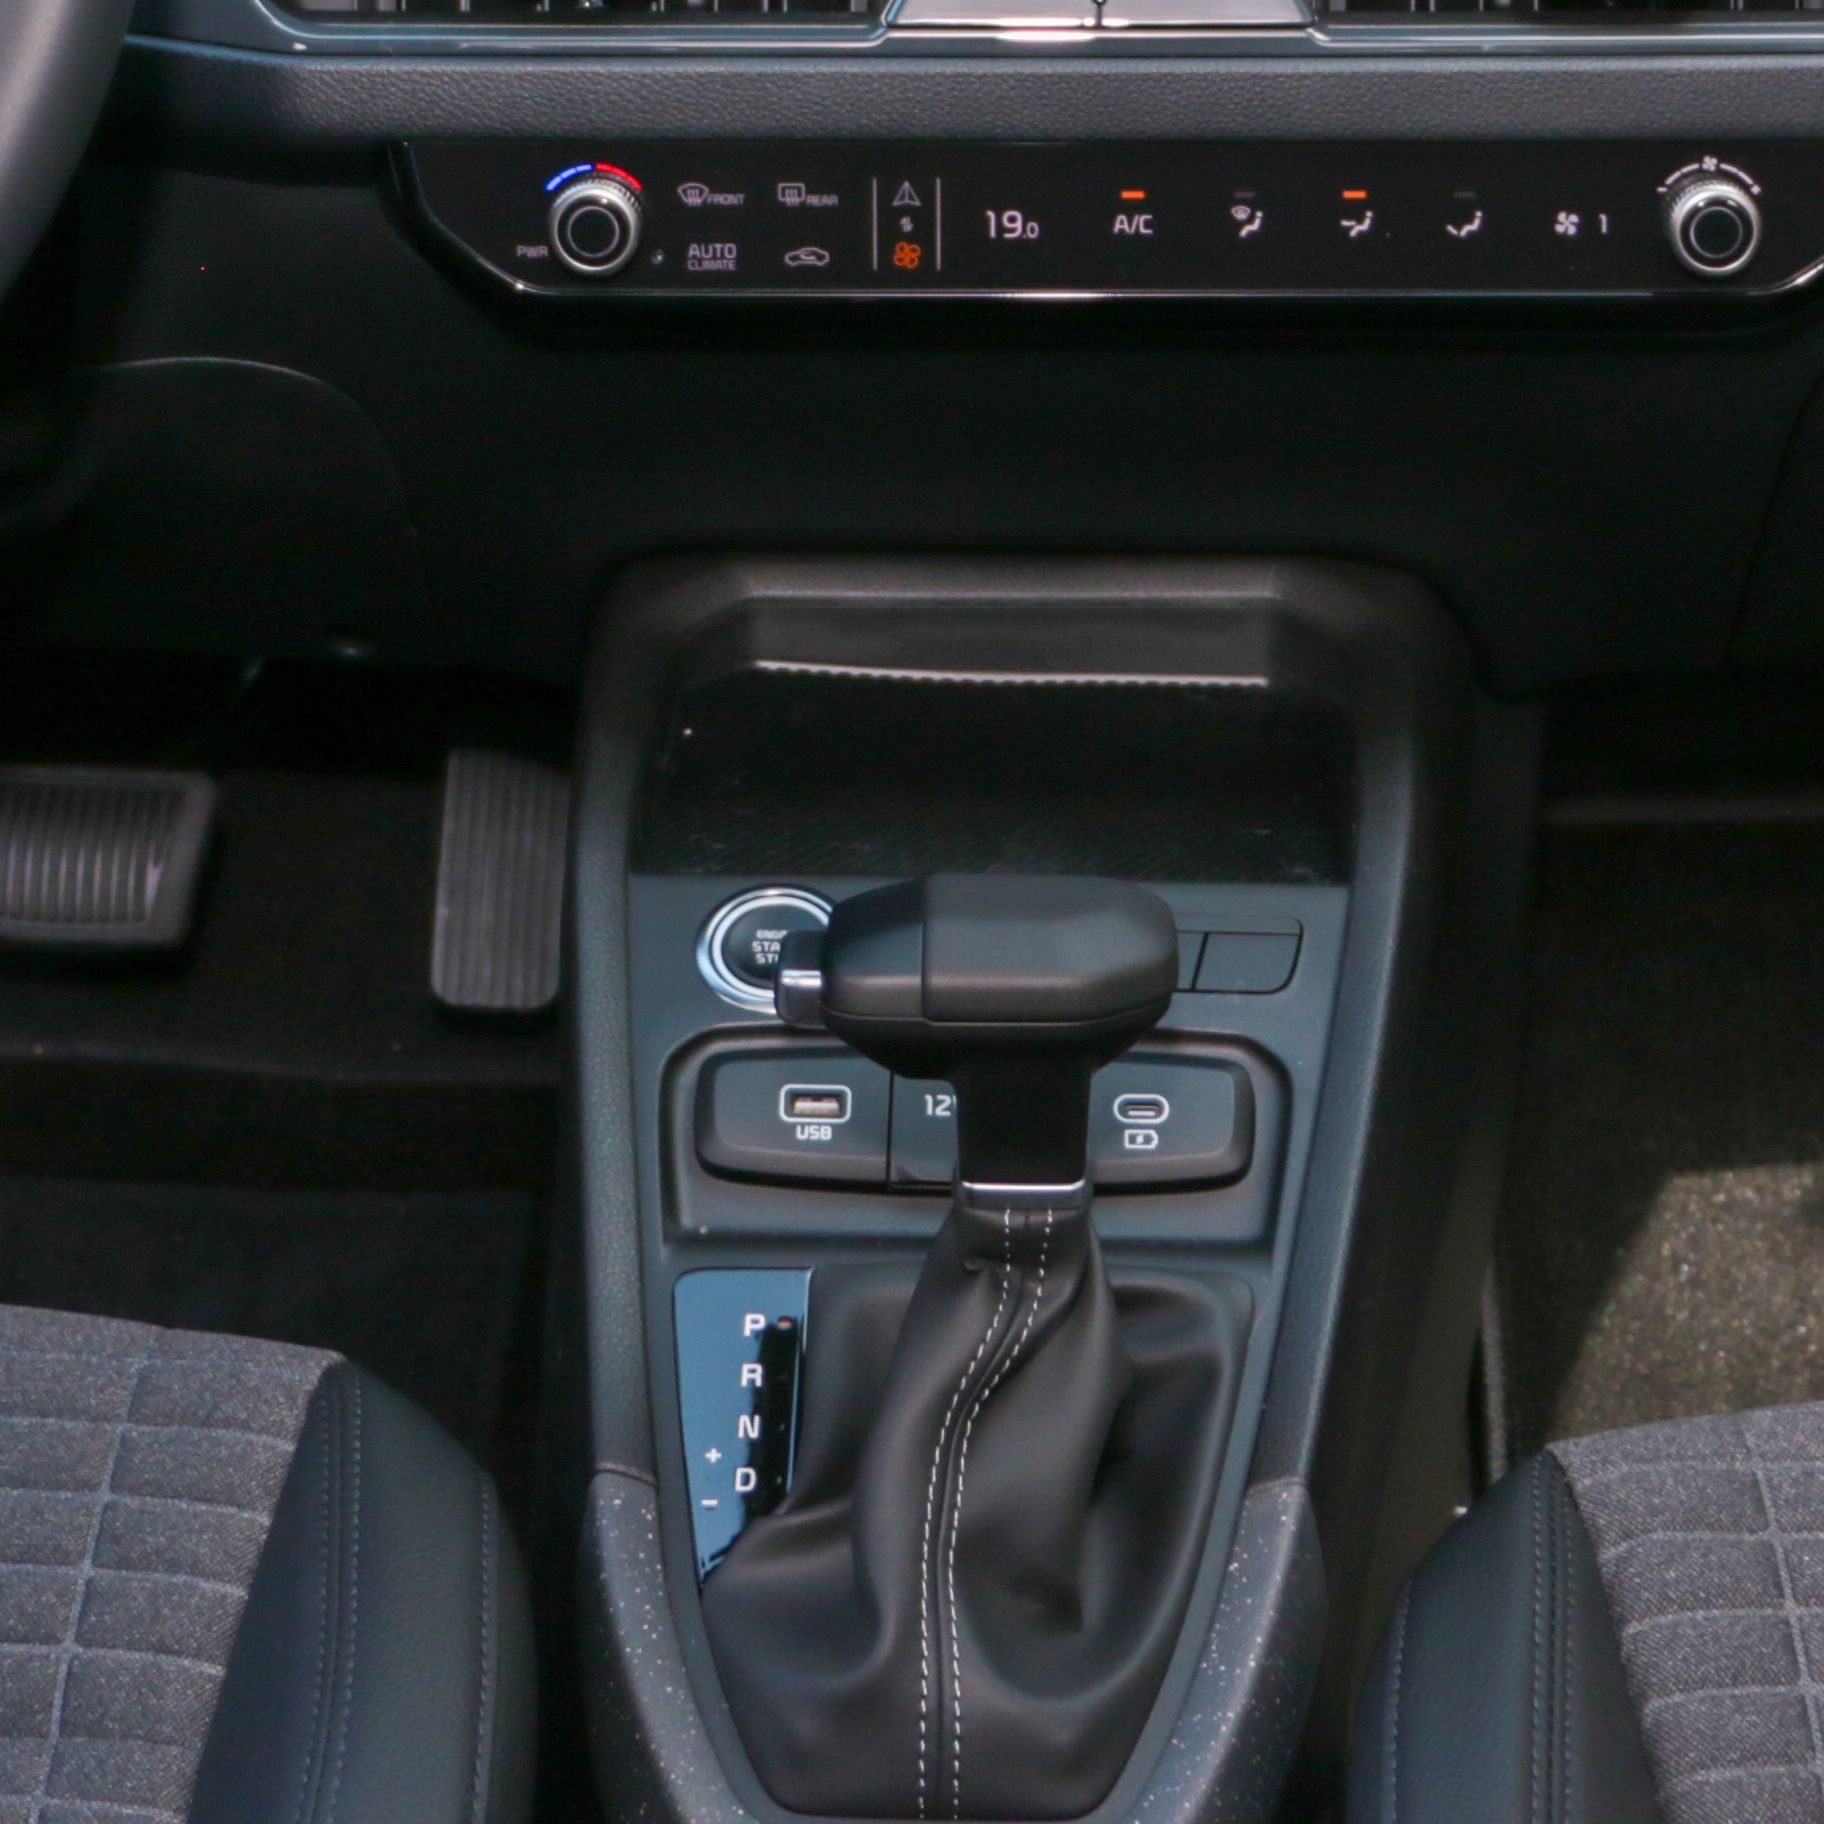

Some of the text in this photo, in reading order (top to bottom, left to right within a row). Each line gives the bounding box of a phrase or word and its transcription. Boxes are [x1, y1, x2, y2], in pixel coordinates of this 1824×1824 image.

[707, 192, 745, 205] FRONT
[806, 194, 838, 206] REAR
[987, 211, 1039, 238] 19.0
[1114, 215, 1152, 234] A/C
[1600, 214, 1607, 233] 1
[516, 245, 548, 258] PWR
[688, 243, 737, 258] AUTO
[687, 258, 736, 271] CLIMATE
[752, 941, 781, 952] STA
[756, 953, 778, 964] ST
[925, 1095, 956, 1116] 12
[795, 1125, 832, 1141] USB
[742, 1313, 766, 1337] P
[740, 1362, 763, 1387] R
[737, 1414, 761, 1439] N
[734, 1467, 757, 1492] D
